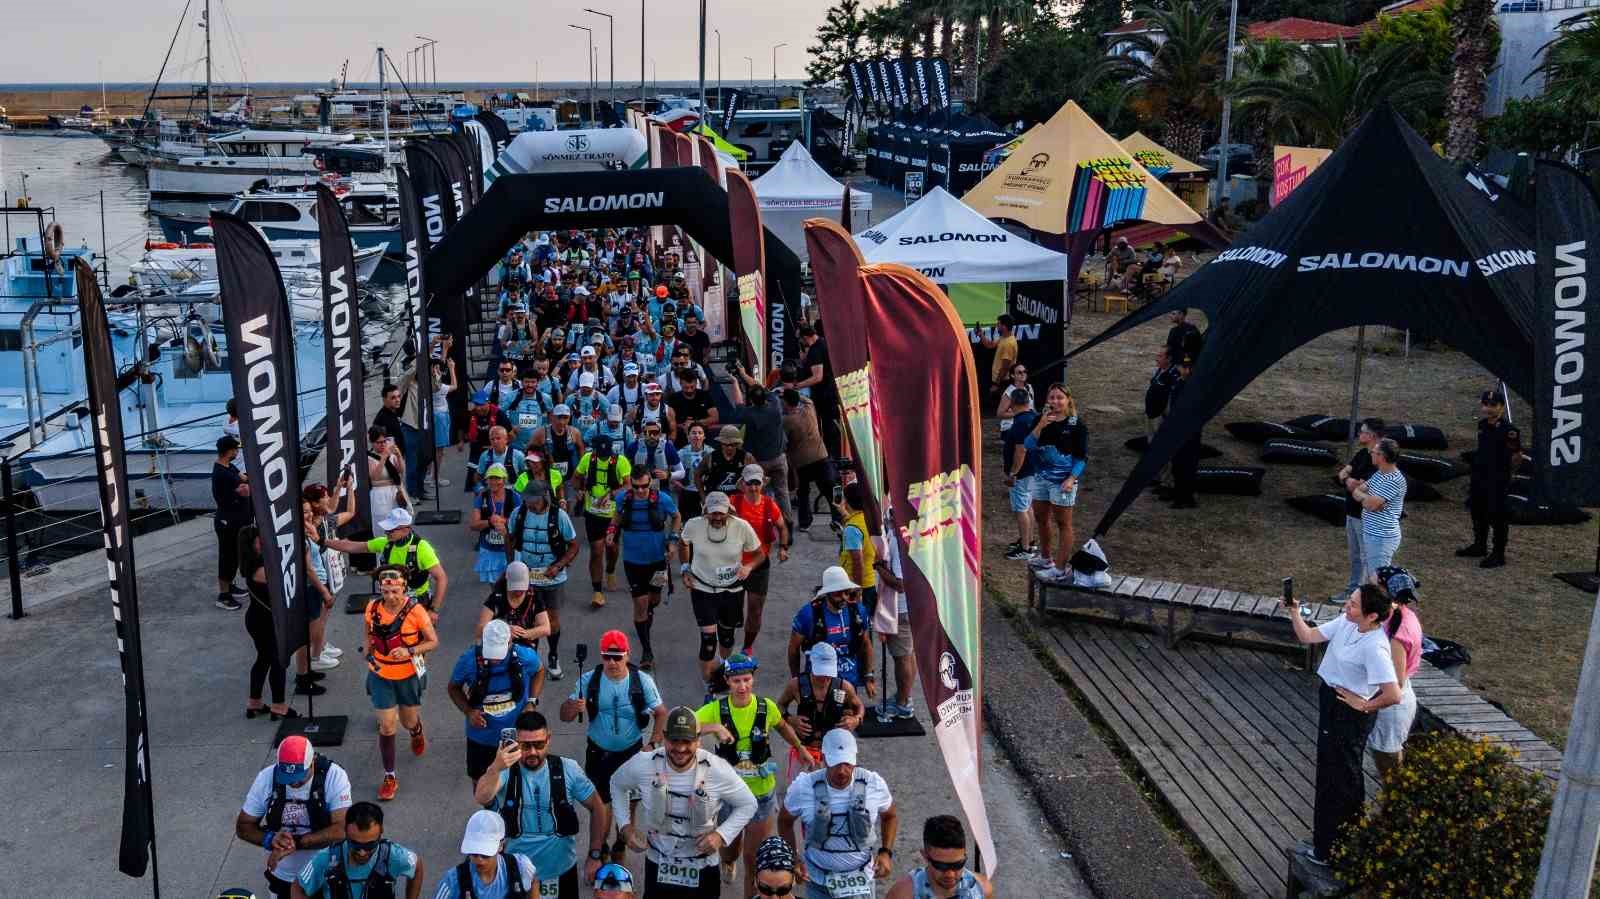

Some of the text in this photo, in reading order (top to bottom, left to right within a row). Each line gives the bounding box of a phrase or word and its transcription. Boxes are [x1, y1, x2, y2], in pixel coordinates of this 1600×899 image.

[544, 192, 663, 213] SALOMON
[899, 232, 1007, 246] SALOMON
[1211, 246, 1288, 269] SALOMON
[1297, 252, 1470, 278] SALOMON
[1016, 293, 1059, 324] SALOMON
[660, 863, 698, 880] 3010
